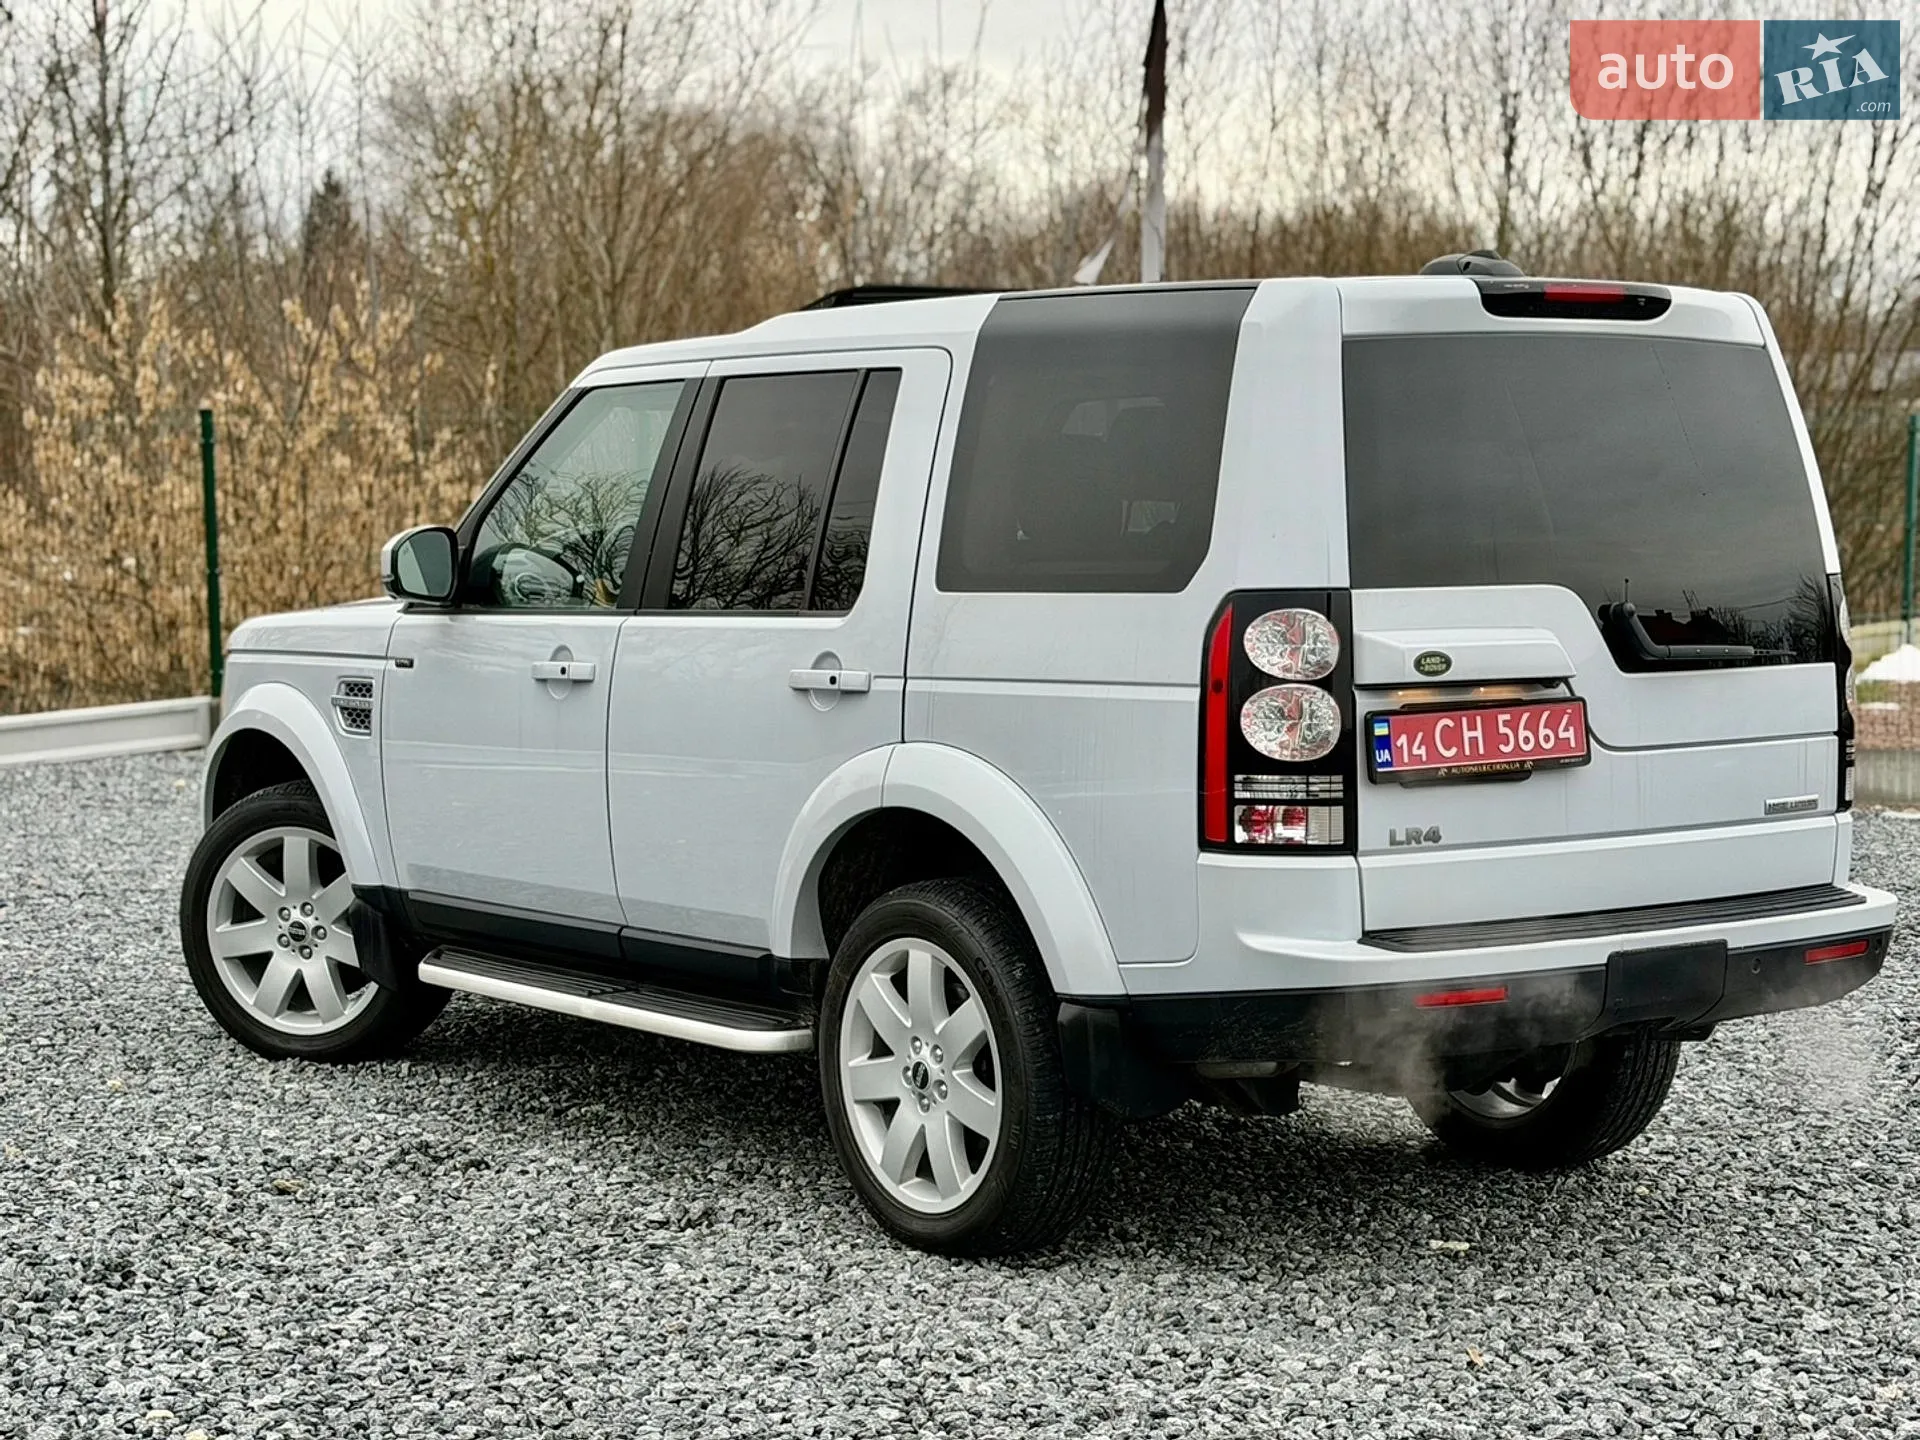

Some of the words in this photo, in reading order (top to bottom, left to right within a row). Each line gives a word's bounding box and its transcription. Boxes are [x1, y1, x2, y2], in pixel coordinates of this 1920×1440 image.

[1396, 731, 1427, 763] 14
[1434, 715, 1485, 758] CH
[1498, 709, 1576, 753] 5664
[1376, 751, 1391, 763] UA
[1389, 826, 1442, 846] LR4
